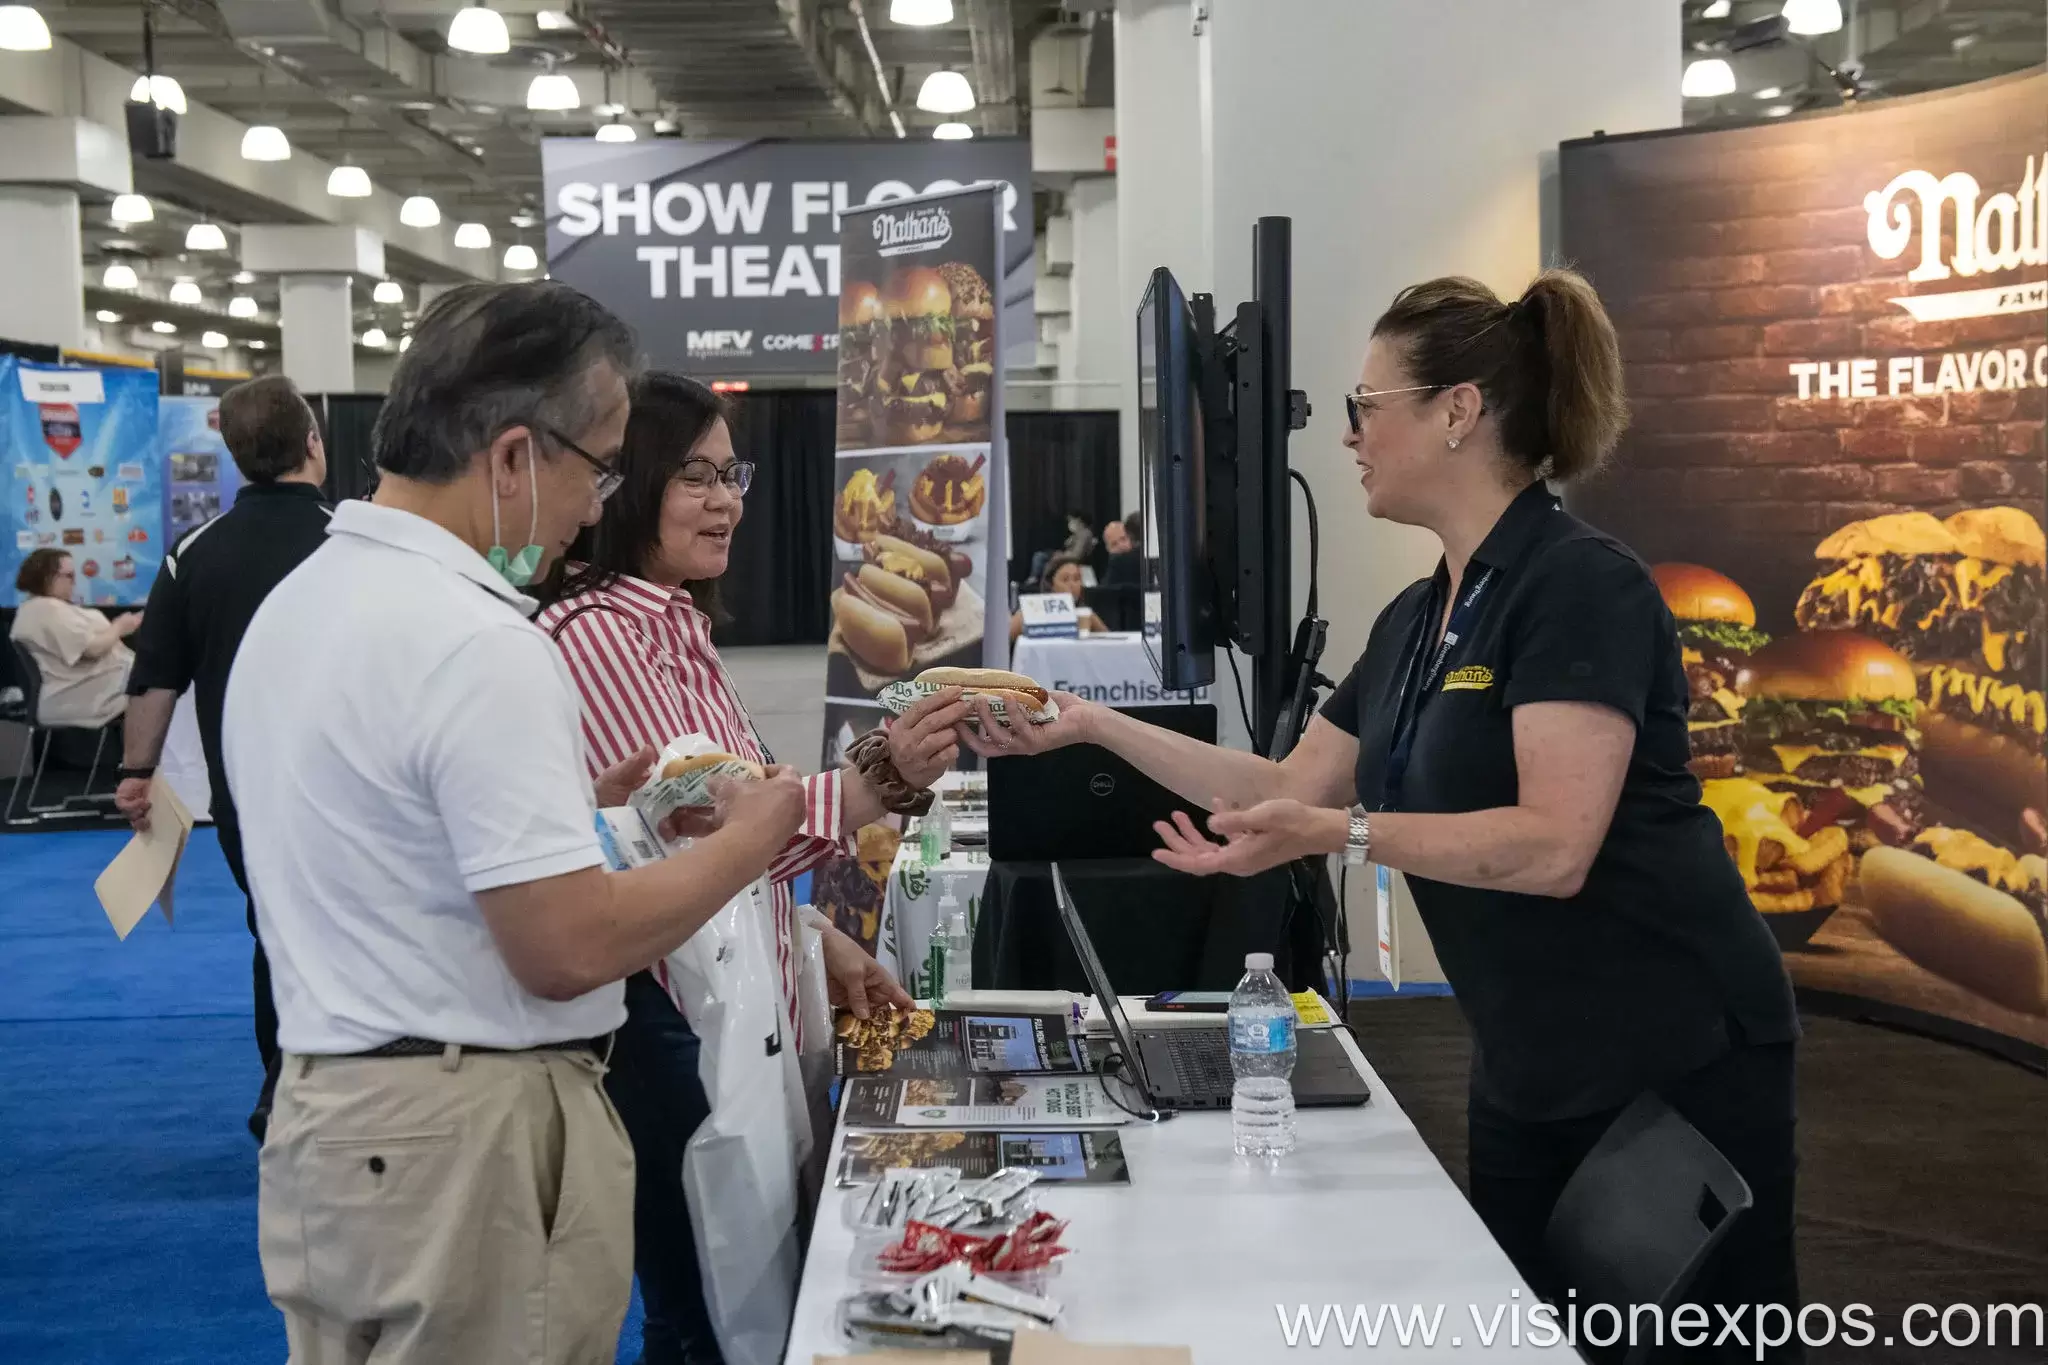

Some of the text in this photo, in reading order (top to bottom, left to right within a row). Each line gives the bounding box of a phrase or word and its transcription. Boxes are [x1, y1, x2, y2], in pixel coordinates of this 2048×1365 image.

[557, 182, 773, 236] SHOW
[872, 206, 951, 246] Nathan's
[637, 244, 842, 299] THEAT
[1997, 289, 2048, 307] FAM
[686, 329, 753, 349] MFV
[1788, 359, 1878, 401] THE
[1888, 347, 2028, 398] FLAVOR
[1043, 599, 1070, 614] IFA
